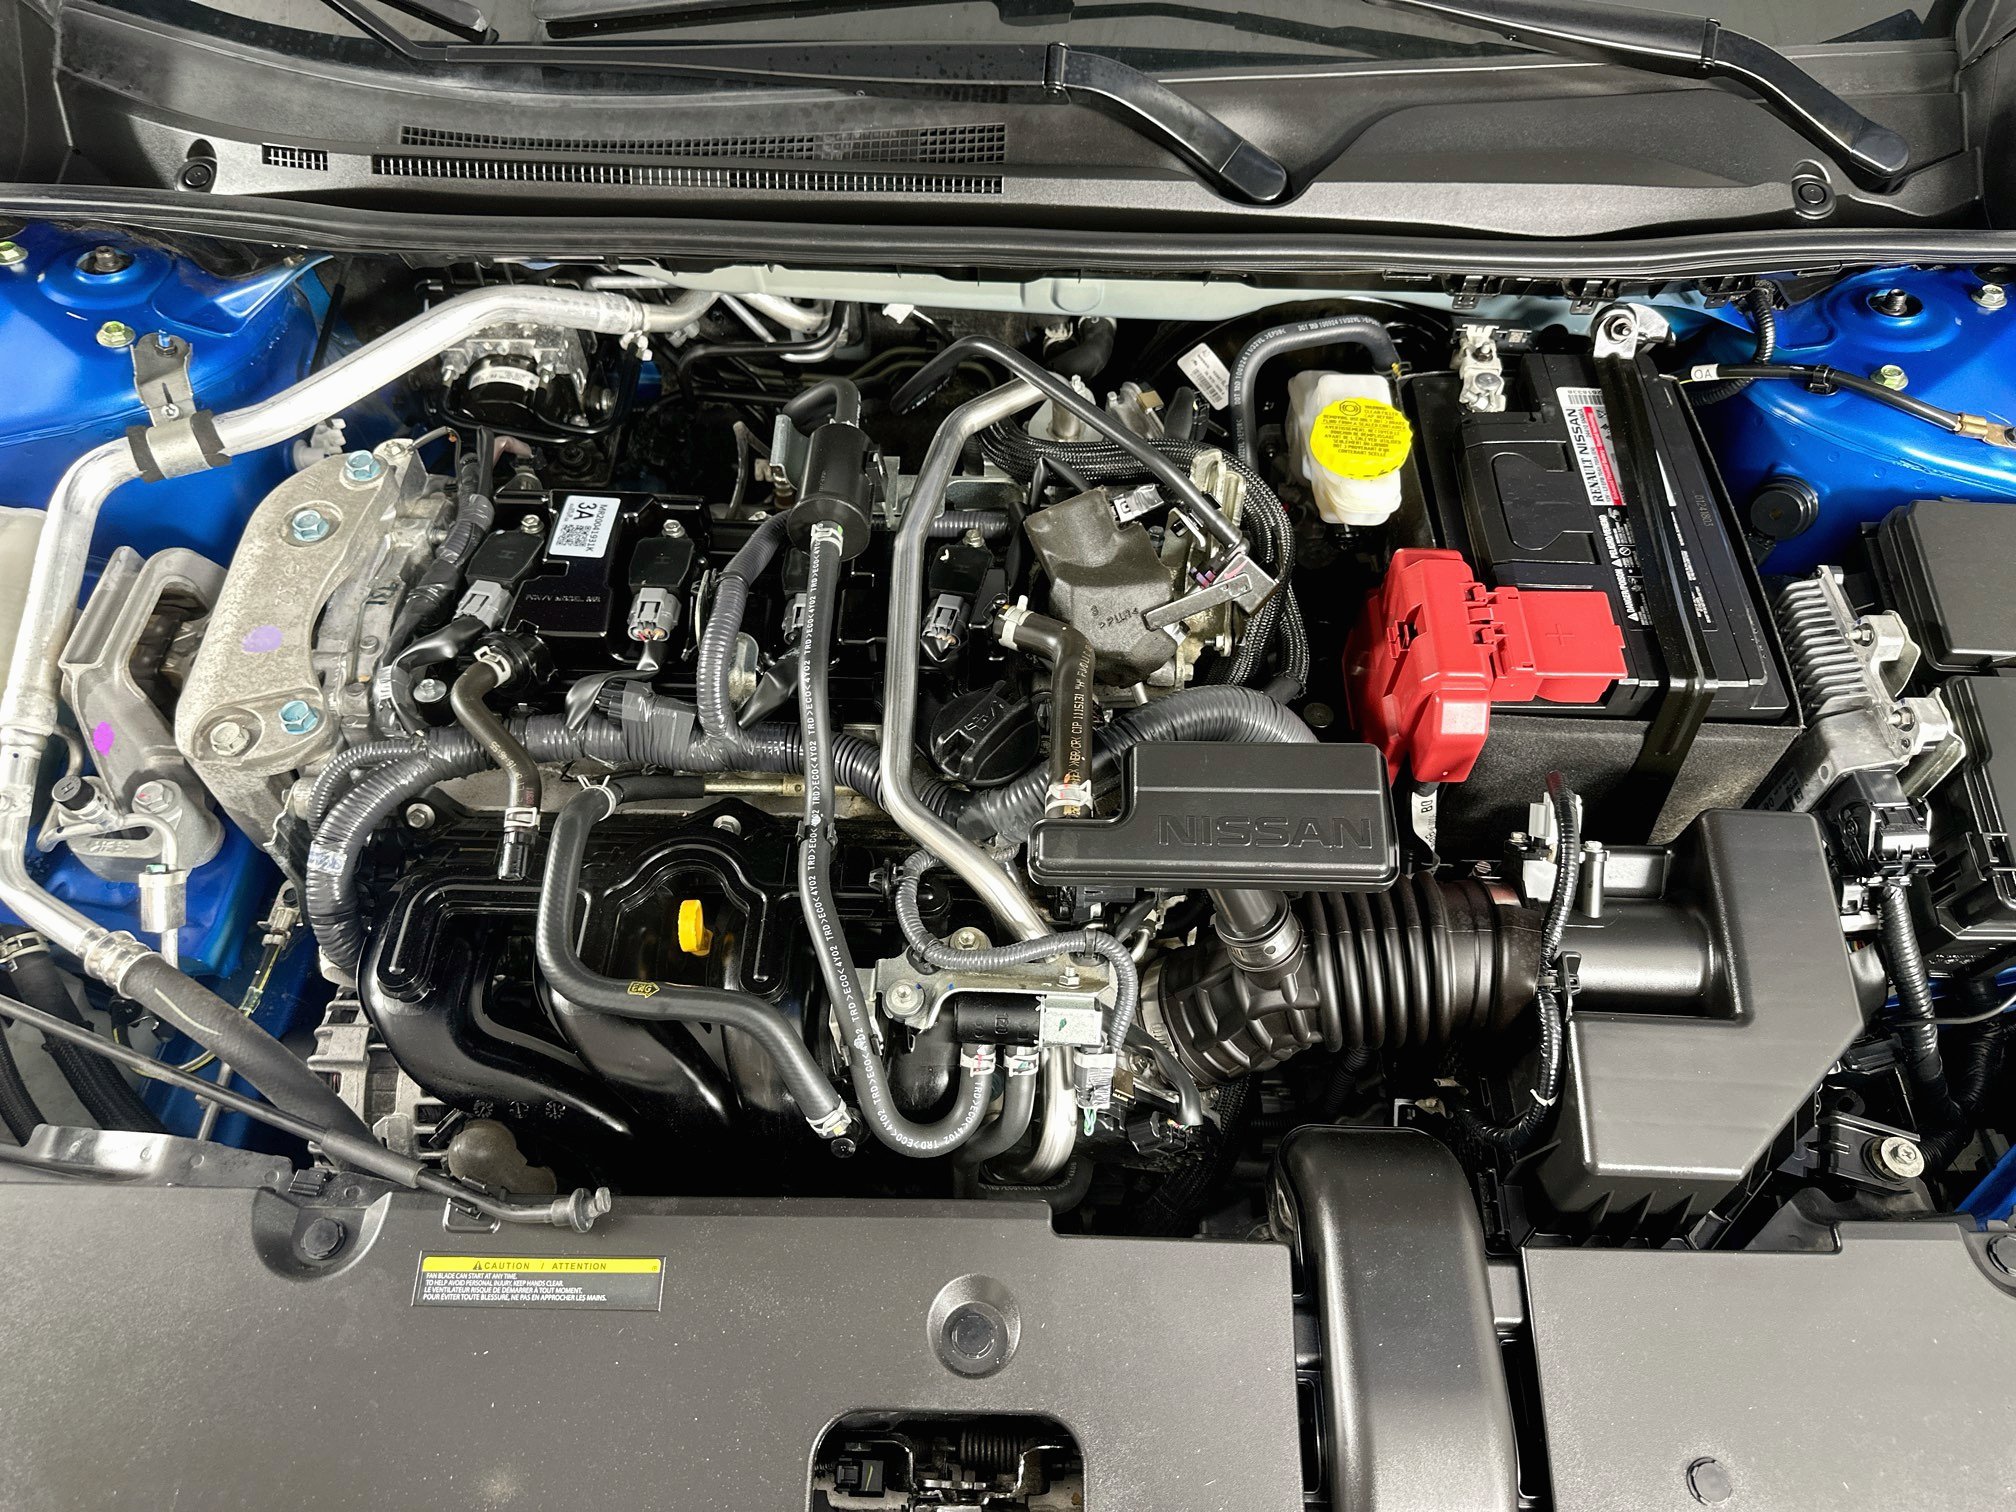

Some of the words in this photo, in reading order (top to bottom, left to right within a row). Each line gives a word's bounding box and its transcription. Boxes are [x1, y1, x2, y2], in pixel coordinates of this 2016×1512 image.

[1566, 409, 1587, 455] NISSAN
[1580, 458, 1604, 503] RENAULT
[574, 502, 597, 520] 3A
[1158, 815, 1372, 849] NISSAN
[631, 983, 652, 993] ENG
